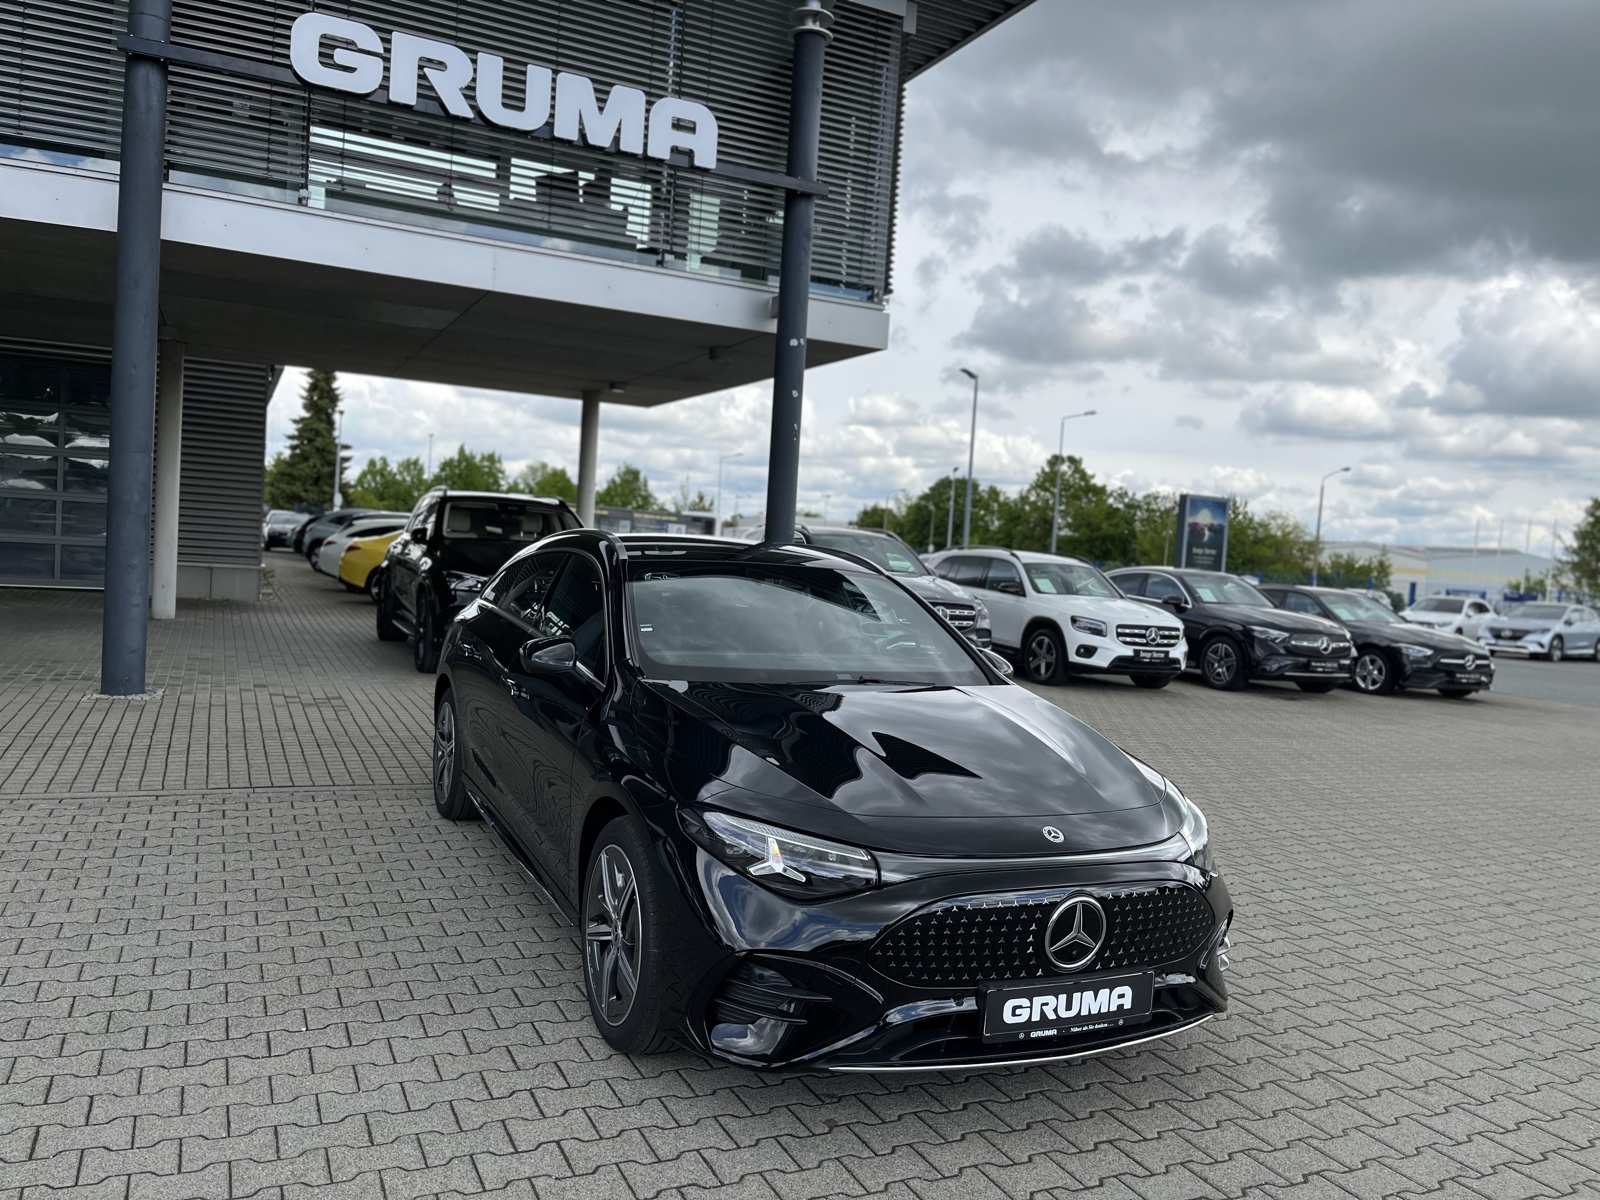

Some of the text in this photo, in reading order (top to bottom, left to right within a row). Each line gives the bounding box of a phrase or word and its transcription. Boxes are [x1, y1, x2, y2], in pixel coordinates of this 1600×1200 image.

[290, 12, 718, 169] GRUMA
[1003, 985, 1133, 1024] GRUMA
[1030, 1029, 1057, 1038] GRUMA
